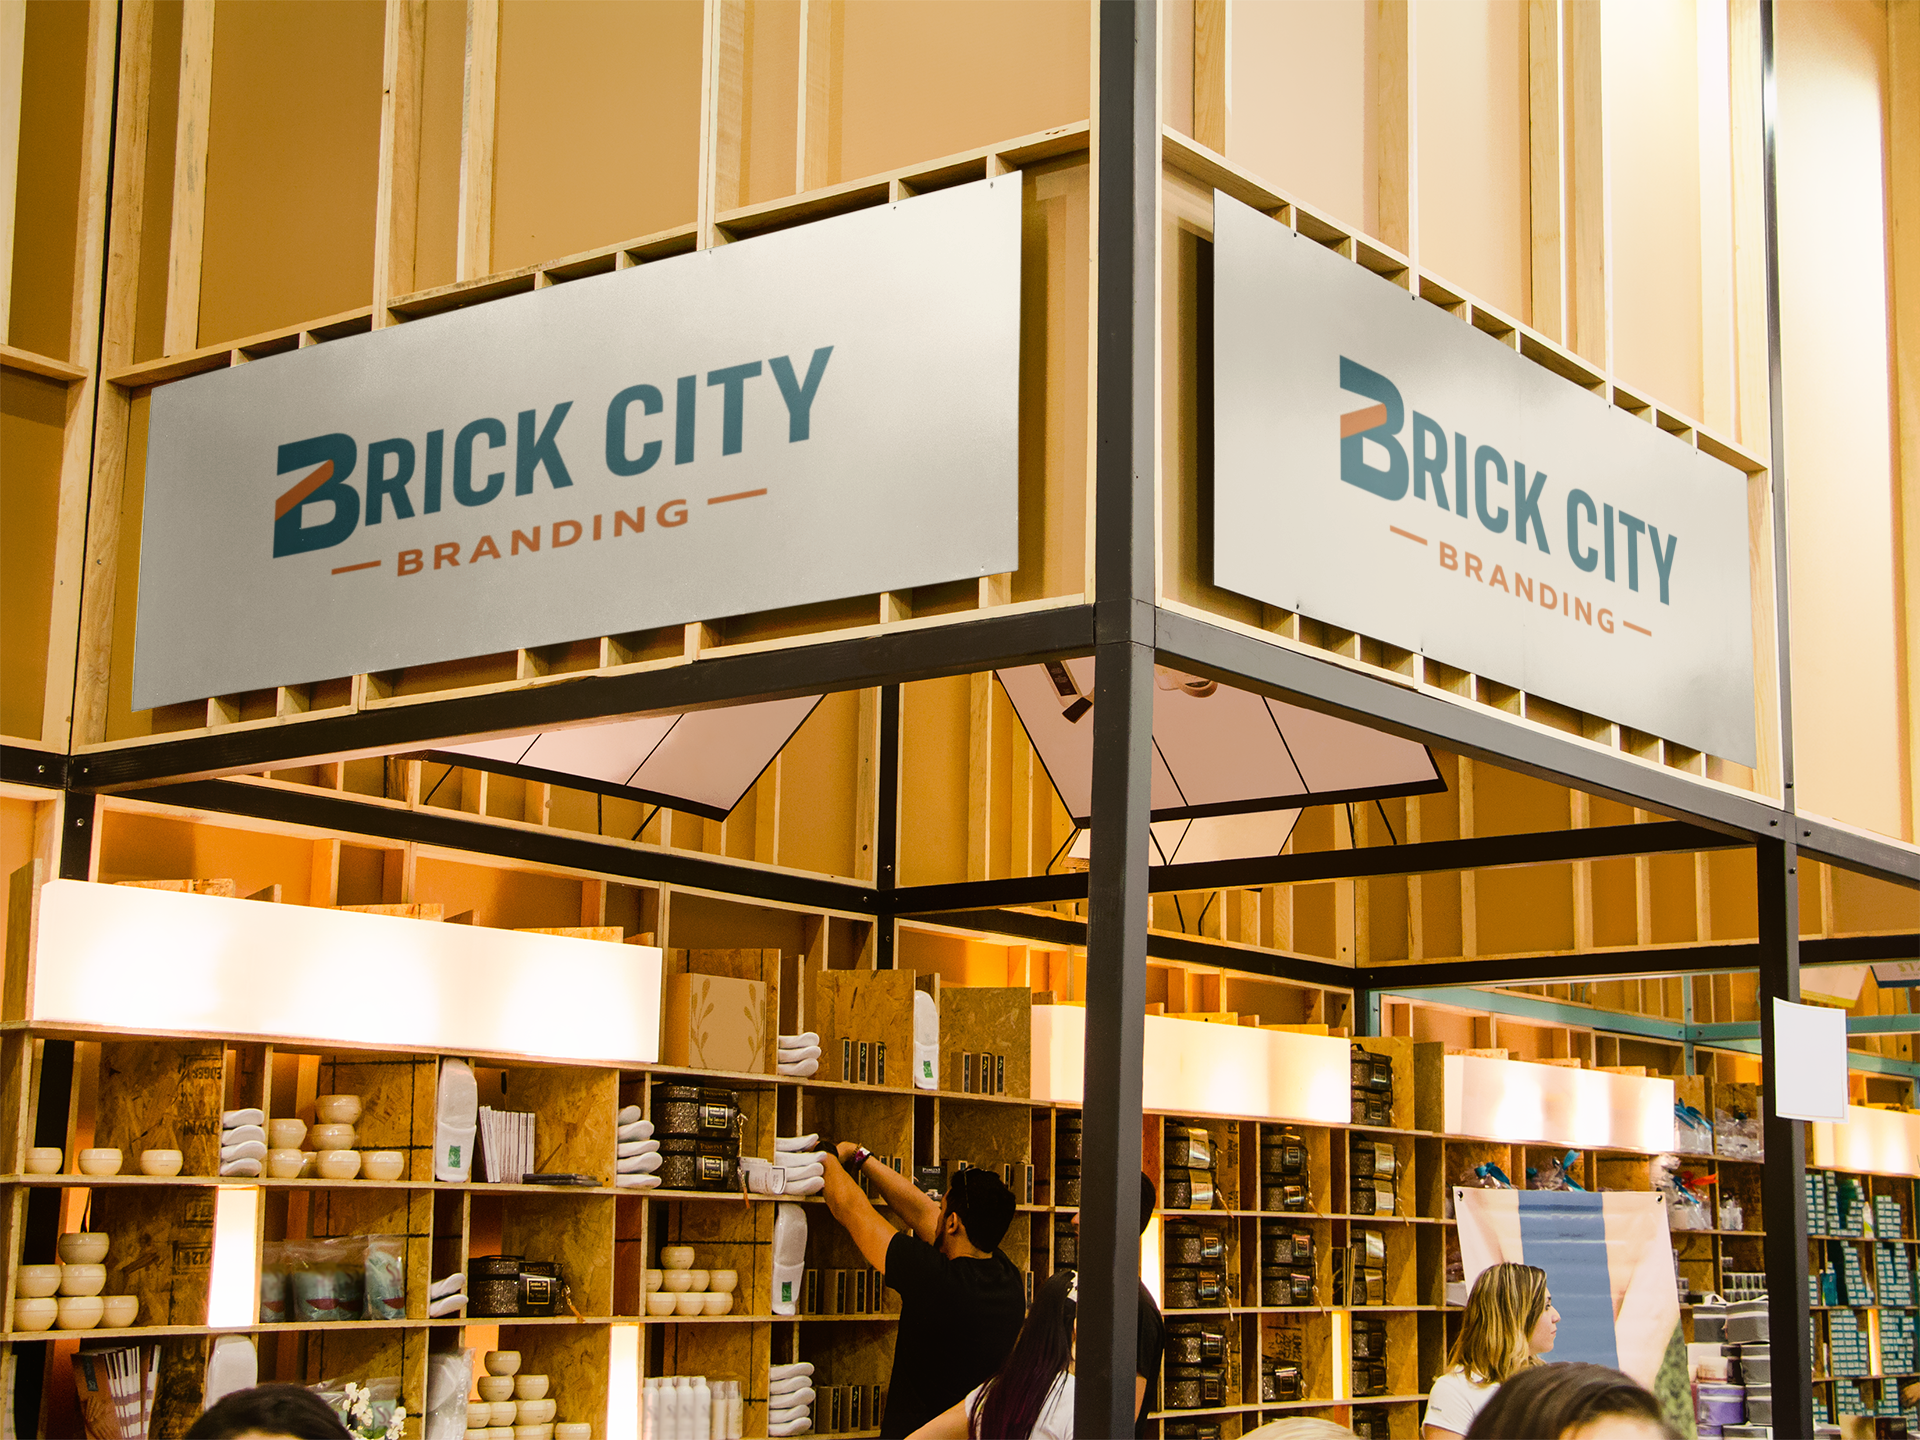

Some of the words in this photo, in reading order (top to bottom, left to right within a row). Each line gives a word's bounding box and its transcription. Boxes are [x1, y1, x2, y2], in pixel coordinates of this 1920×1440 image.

[272, 400, 574, 559] BRICK
[604, 345, 835, 478] CITY
[1338, 354, 1552, 556] BRICK
[1565, 487, 1679, 606] CITY
[396, 498, 689, 578] BRANDING
[1438, 541, 1616, 635] BRANDING
